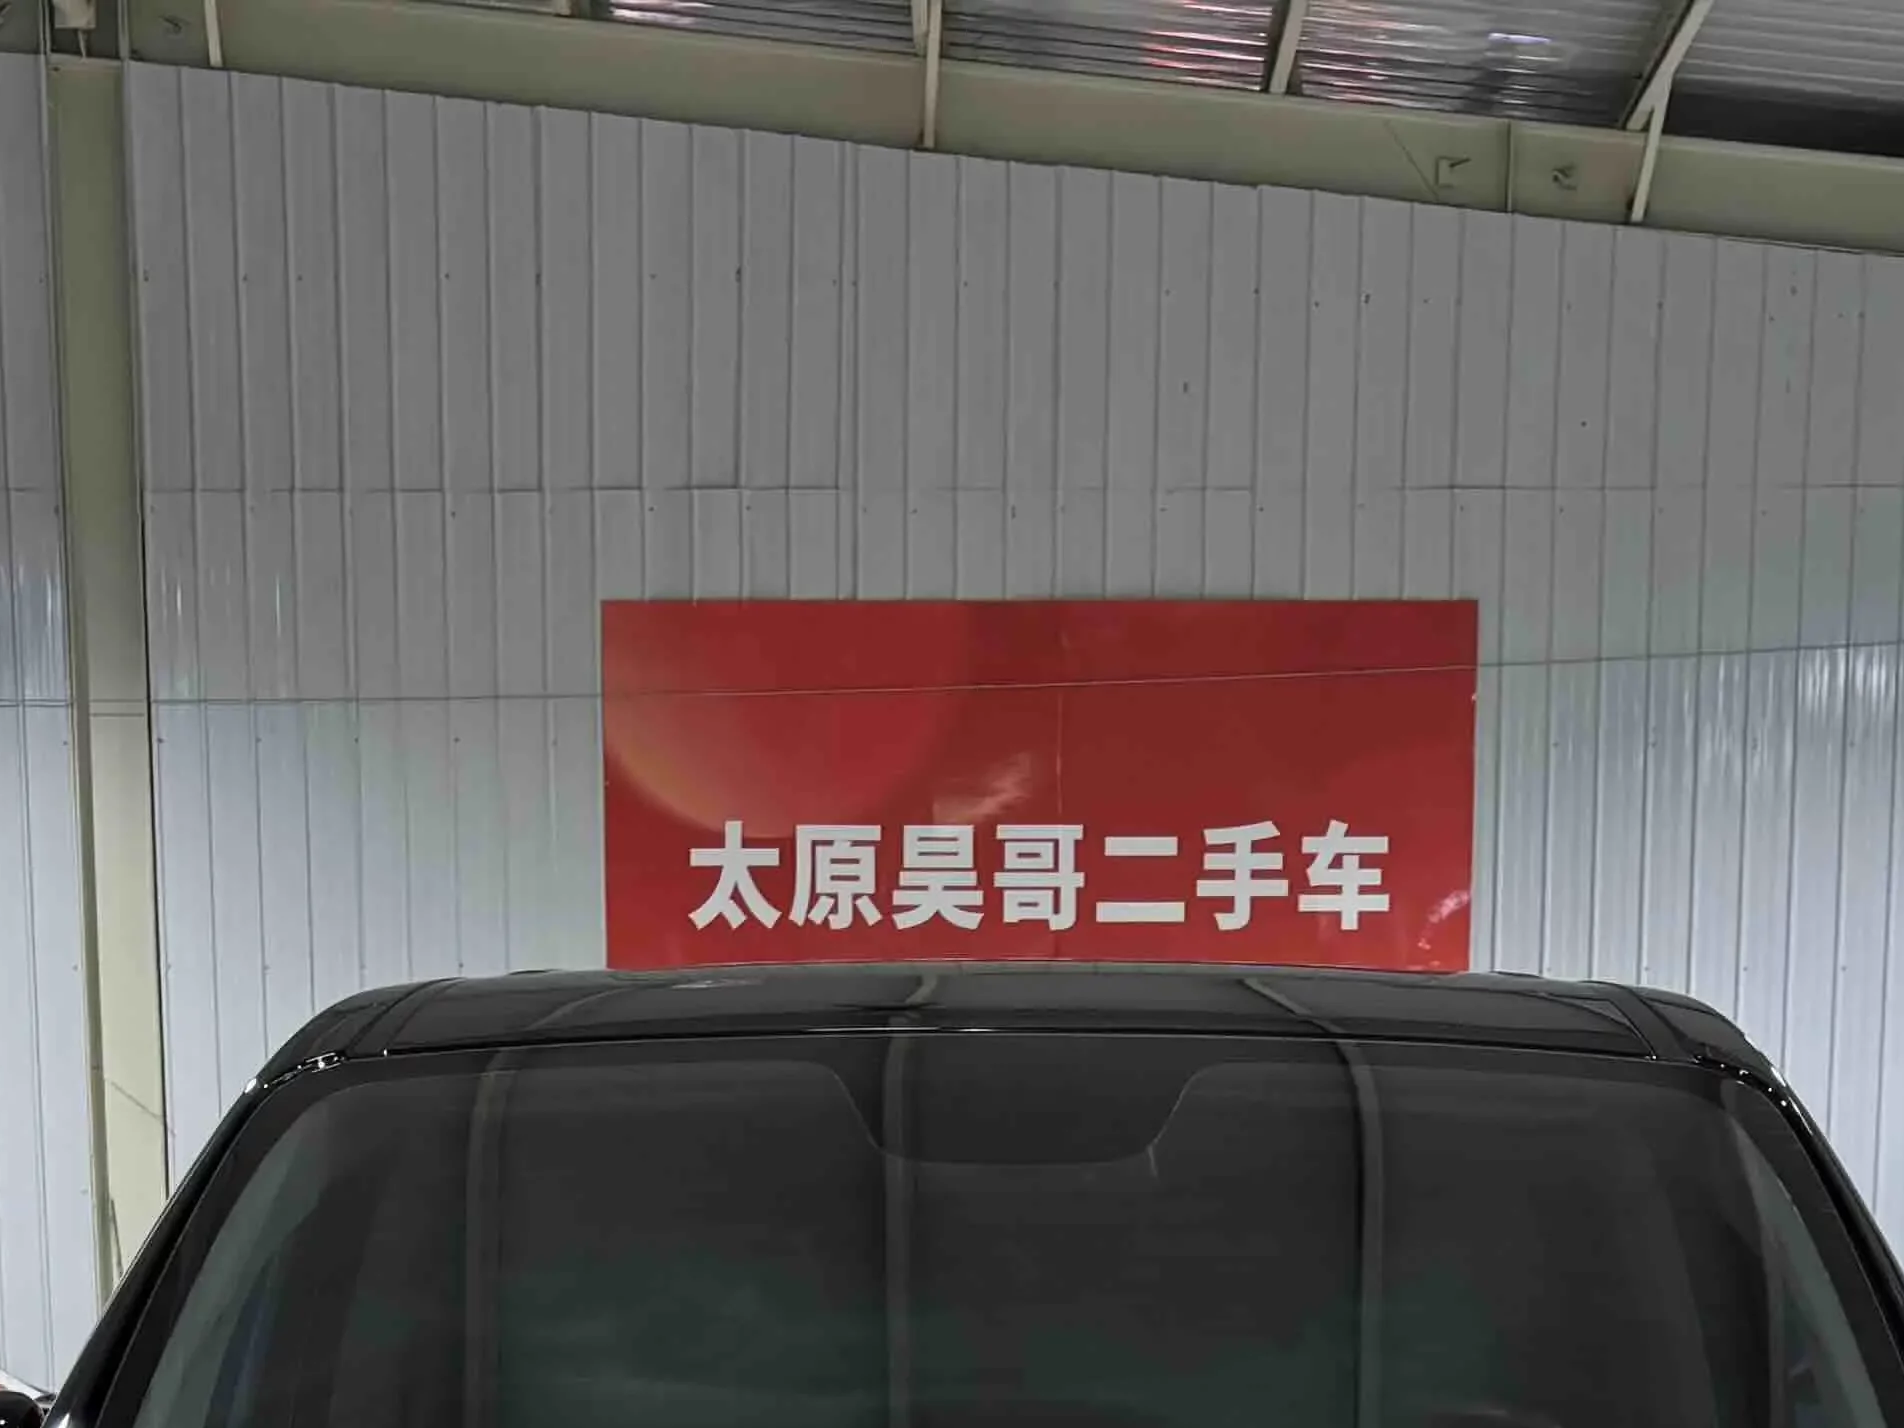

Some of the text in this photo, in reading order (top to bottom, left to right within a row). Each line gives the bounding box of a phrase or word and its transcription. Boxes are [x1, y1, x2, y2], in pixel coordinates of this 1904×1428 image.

[689, 820, 1391, 930] 太原昊哥二手车
